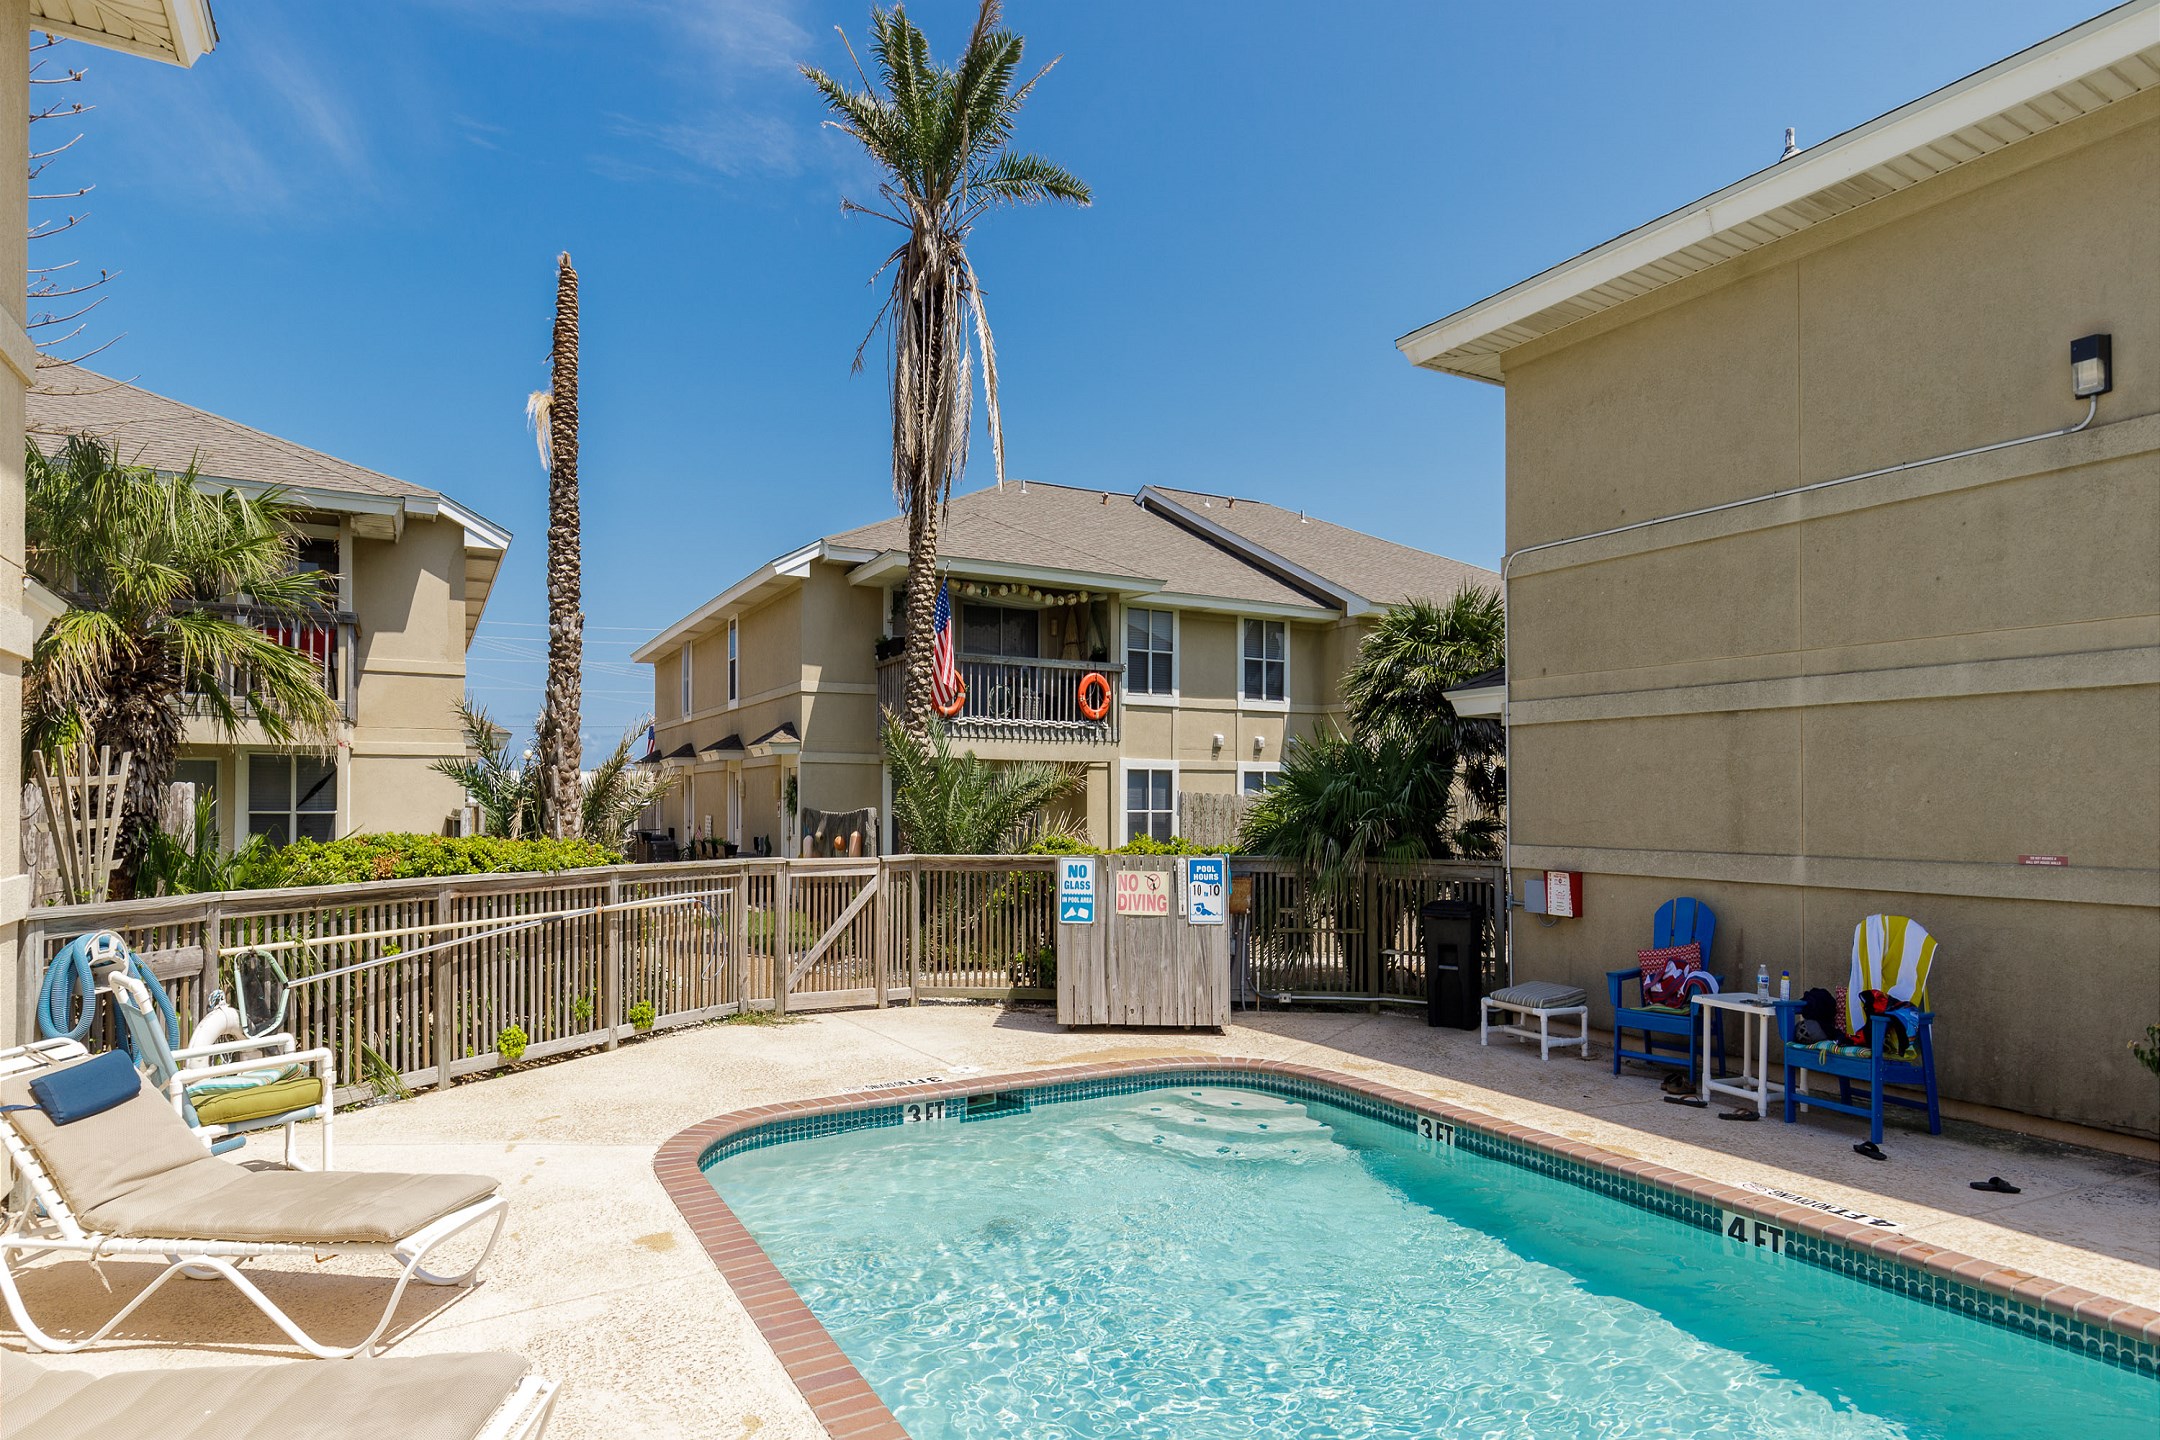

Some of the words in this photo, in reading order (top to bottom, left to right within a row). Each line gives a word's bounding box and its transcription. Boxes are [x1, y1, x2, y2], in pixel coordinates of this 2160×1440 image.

[1067, 864, 1088, 879] NO
[1196, 865, 1216, 873] POOL
[1117, 874, 1139, 892] NO
[1193, 873, 1219, 881] HOURS
[1064, 880, 1091, 890] GLASS
[1193, 884, 1202, 896] 10
[1209, 884, 1221, 896] 10
[1080, 896, 1093, 904] AREA
[1117, 893, 1168, 912] DIVING
[907, 1104, 921, 1122] 3
[925, 1101, 945, 1121] FT
[1420, 1118, 1432, 1139] 3
[1436, 1122, 1454, 1146] FT
[1768, 1189, 1816, 1206] DIVING
[1814, 1201, 1834, 1212] NO
[1827, 1208, 1868, 1220] FT
[1868, 1218, 1897, 1227] 4
[1727, 1216, 1748, 1244] 4
[1754, 1221, 1783, 1254] FT
